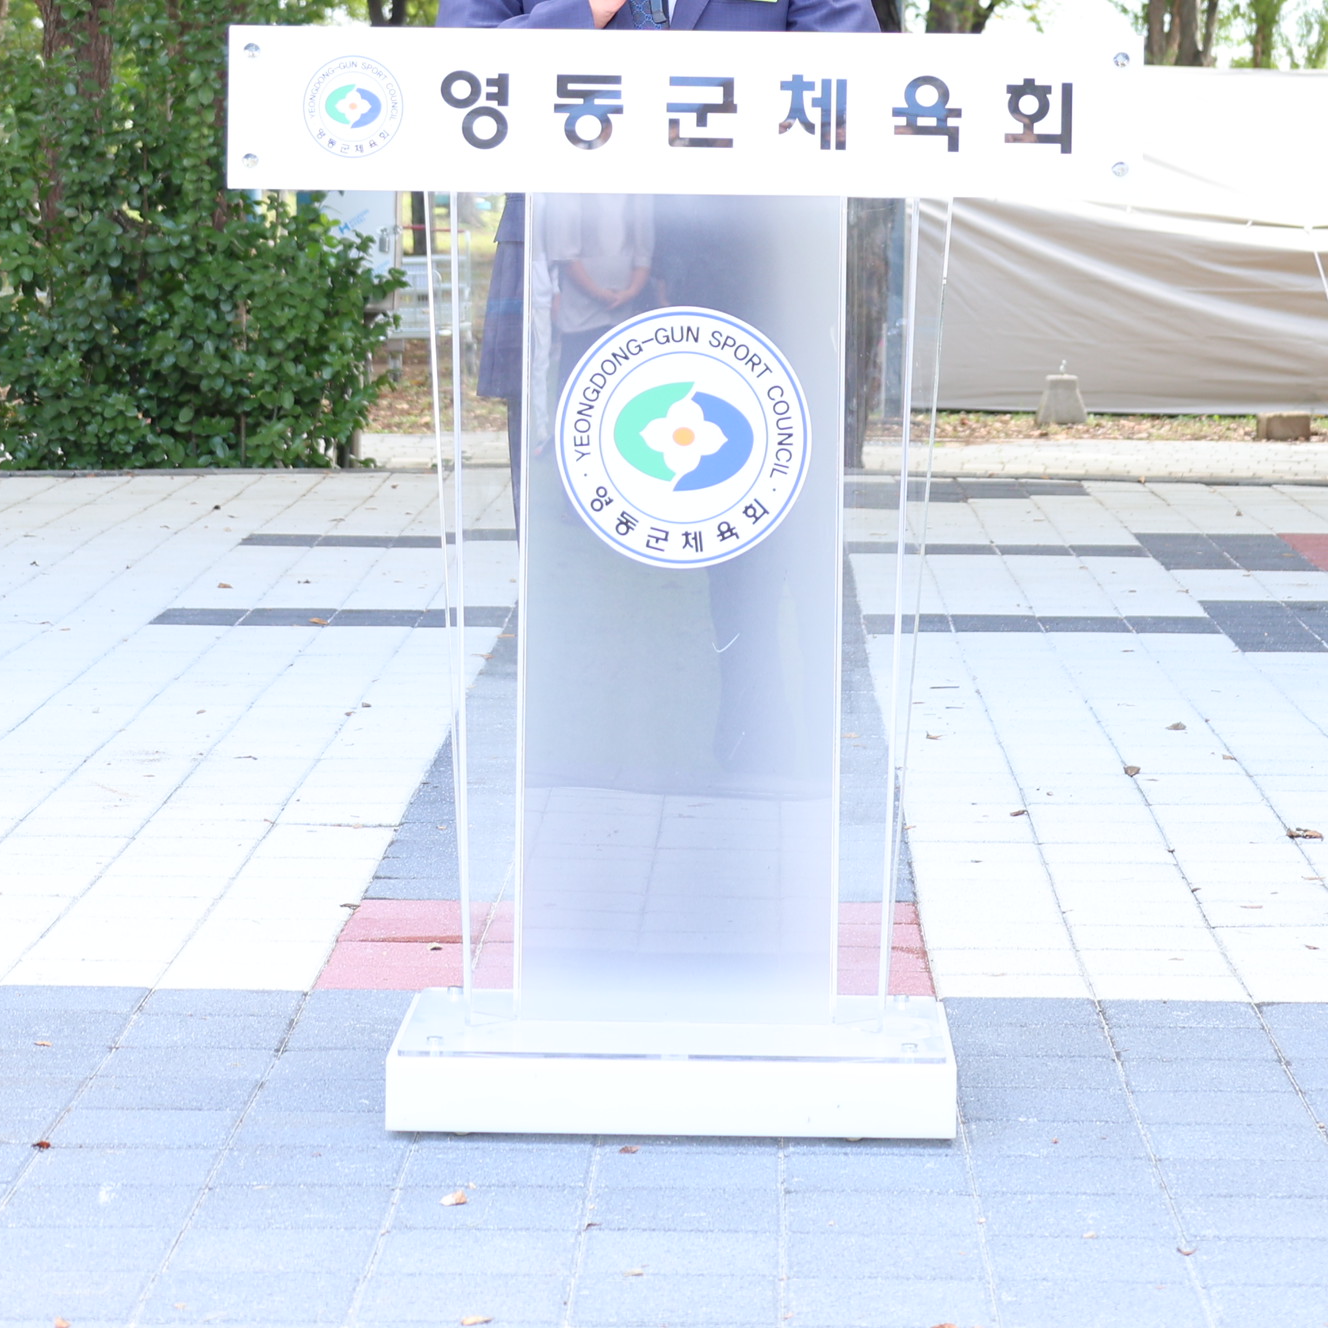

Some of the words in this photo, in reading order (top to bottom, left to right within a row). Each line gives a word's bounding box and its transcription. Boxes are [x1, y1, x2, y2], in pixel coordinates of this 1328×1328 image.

[441, 70, 1073, 154] 영동군체육회
[573, 325, 700, 462] YEONGDONG-GUN
[708, 330, 773, 380] SPORT
[767, 385, 794, 478] COUNCIL
[590, 486, 770, 553] 영동군체육회
